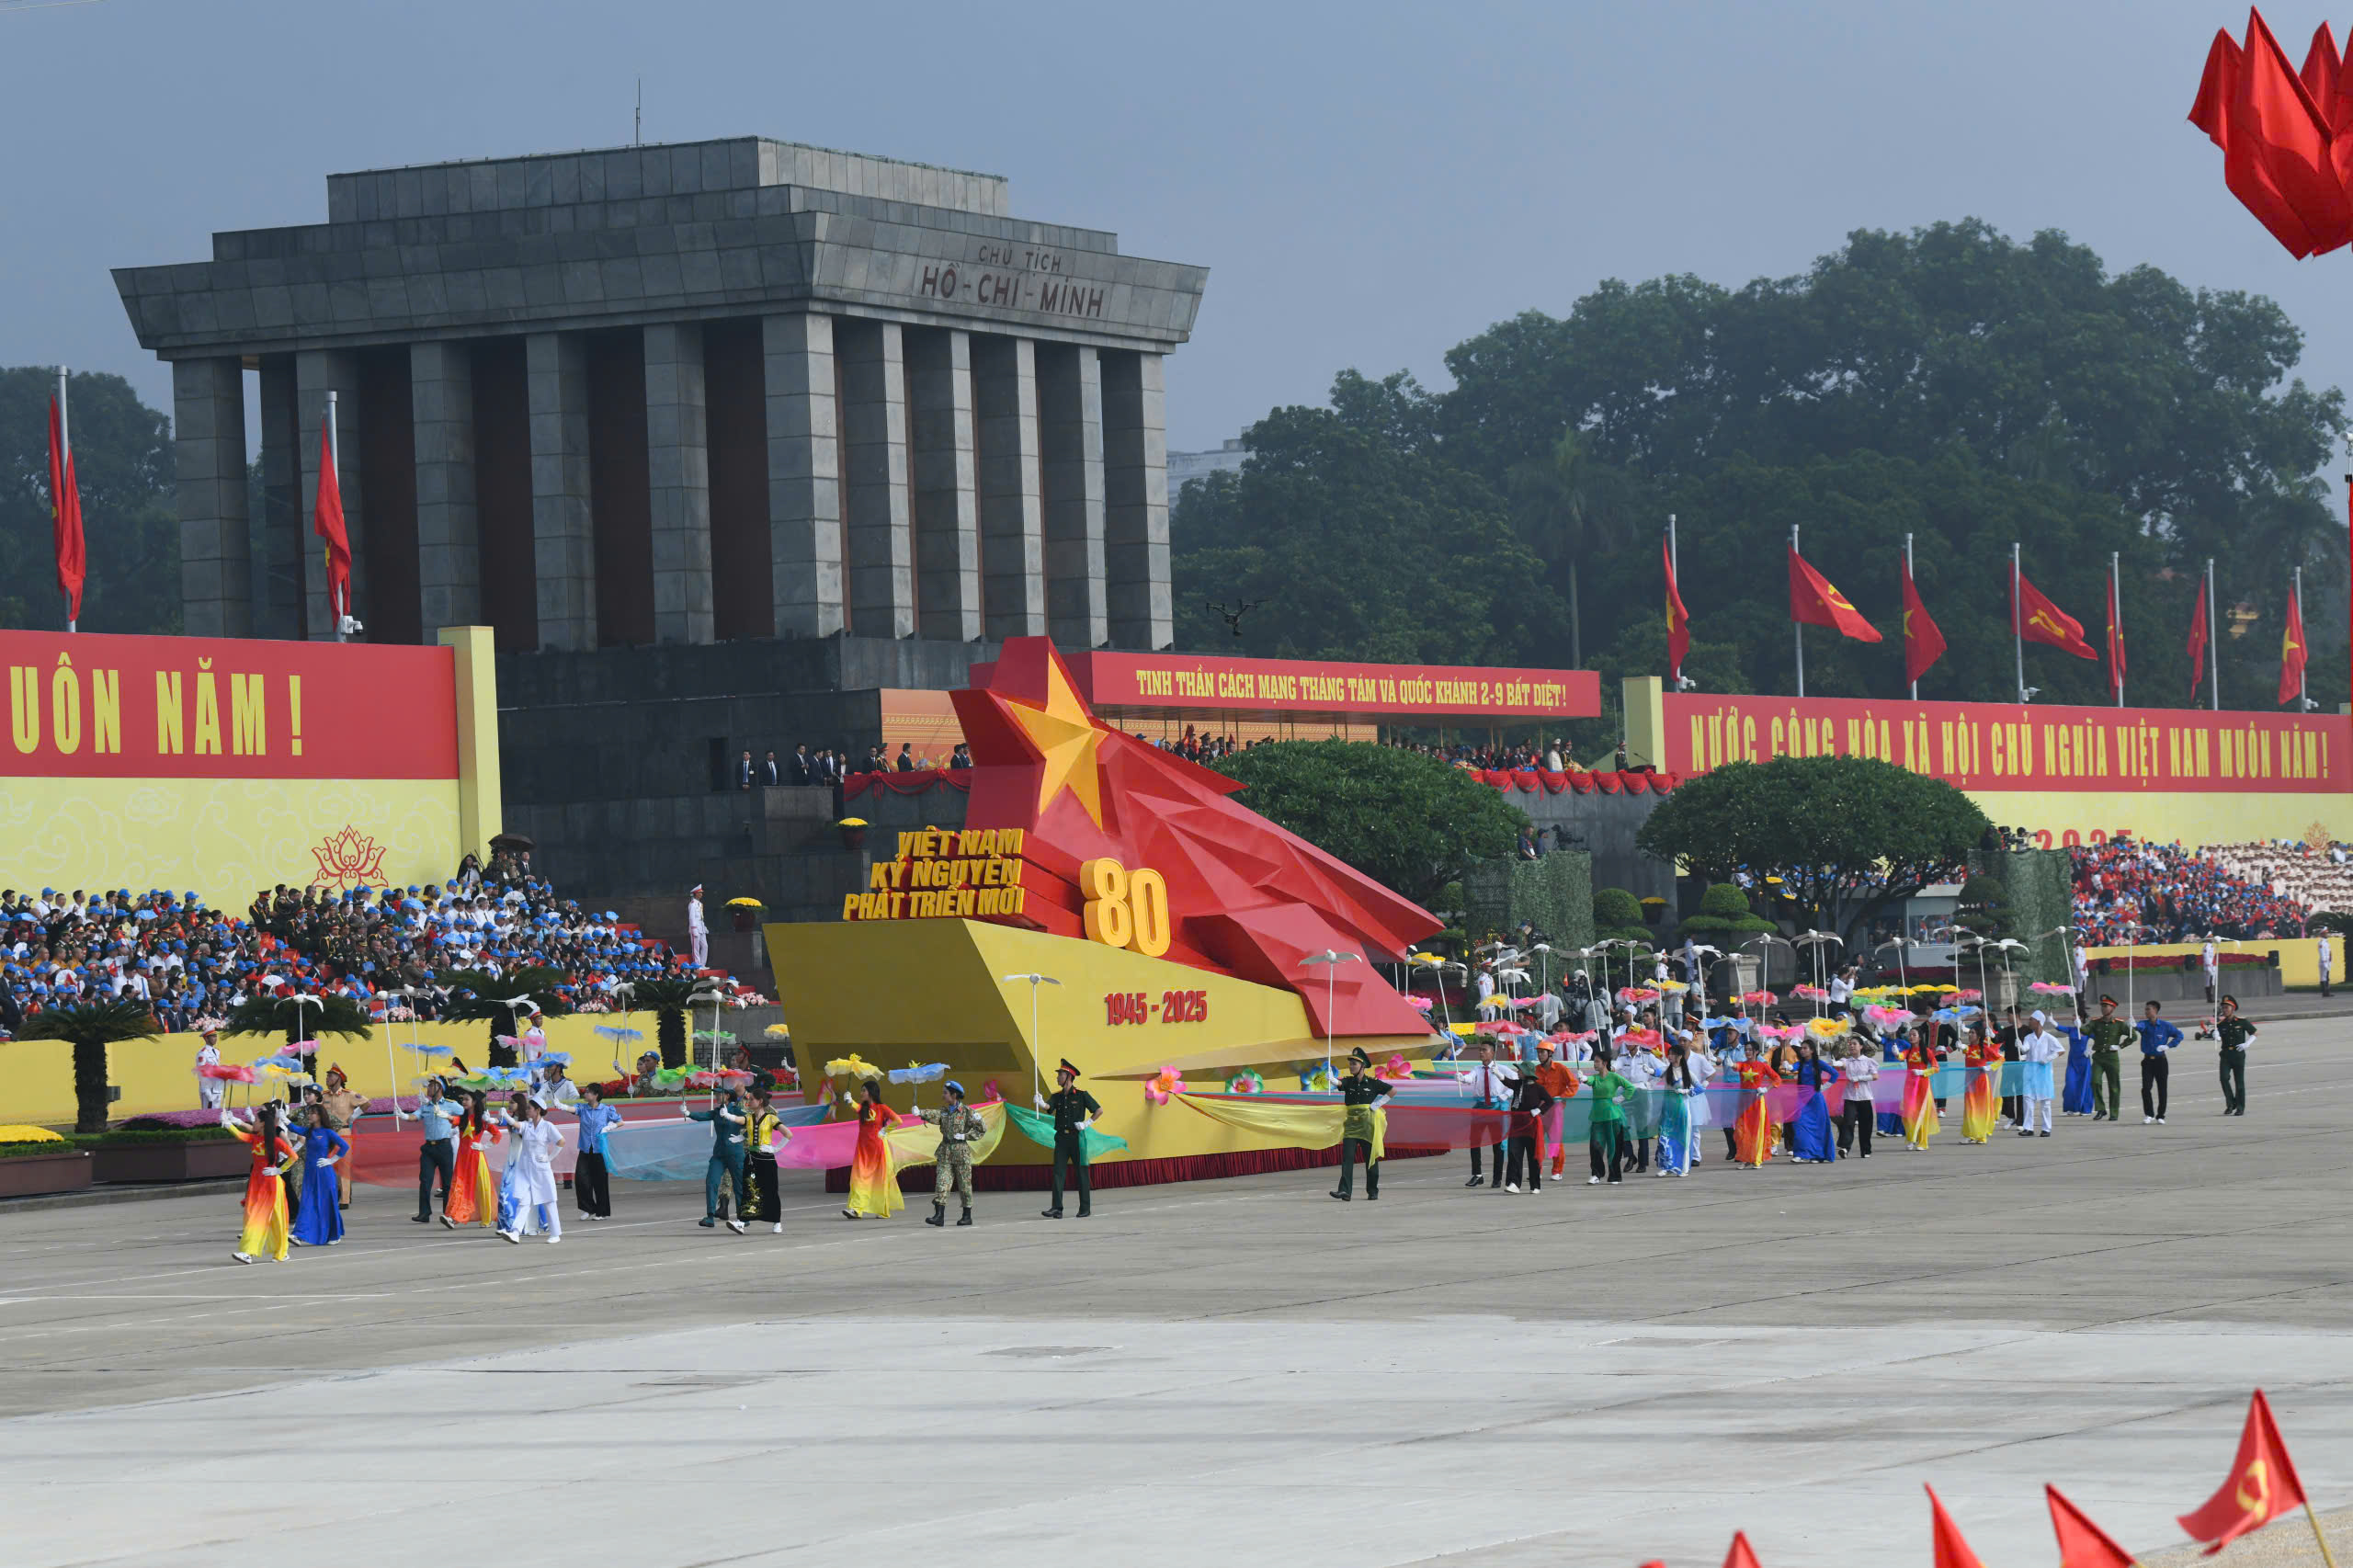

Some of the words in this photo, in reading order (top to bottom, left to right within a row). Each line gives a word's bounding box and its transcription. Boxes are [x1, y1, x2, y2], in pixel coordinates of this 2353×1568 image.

[1040, 275, 1103, 317] MINH
[155, 656, 267, 756] NĂM
[1136, 670, 1173, 697] TINH
[1176, 664, 1214, 698] THẦN
[1218, 667, 1255, 699] CÁCH
[1258, 675, 1297, 705] MẠNG
[1300, 671, 1345, 702] THÁNG
[1347, 673, 1376, 703] TÁM
[1379, 674, 1397, 704] VÀ
[1400, 673, 1433, 705] QUỐC
[1436, 676, 1478, 705] KHÁNH
[1481, 682, 1504, 706] 2-9
[1506, 676, 1530, 707] BẤT
[1690, 705, 1757, 772] NƯỚC
[1903, 712, 1931, 774] XÃ
[1942, 711, 1980, 785] HỘI
[1991, 710, 2033, 777] CHỦ
[2044, 718, 2108, 777] NGHĨA
[2117, 717, 2159, 787] VIỆT
[2169, 727, 2210, 778] NAM
[2219, 721, 2271, 778] MUÔN
[898, 825, 955, 861] VIỆT
[958, 828, 1024, 856] NAM
[870, 853, 907, 889] KỶ
[911, 853, 1022, 887] NGUYÊN
[843, 888, 904, 920] PHÁT
[909, 880, 976, 918] TRIỂN
[977, 881, 1025, 915] MỚI
[1080, 857, 1170, 957] 80
[1104, 992, 1147, 1026] 1945
[1162, 989, 1208, 1024] 2025
